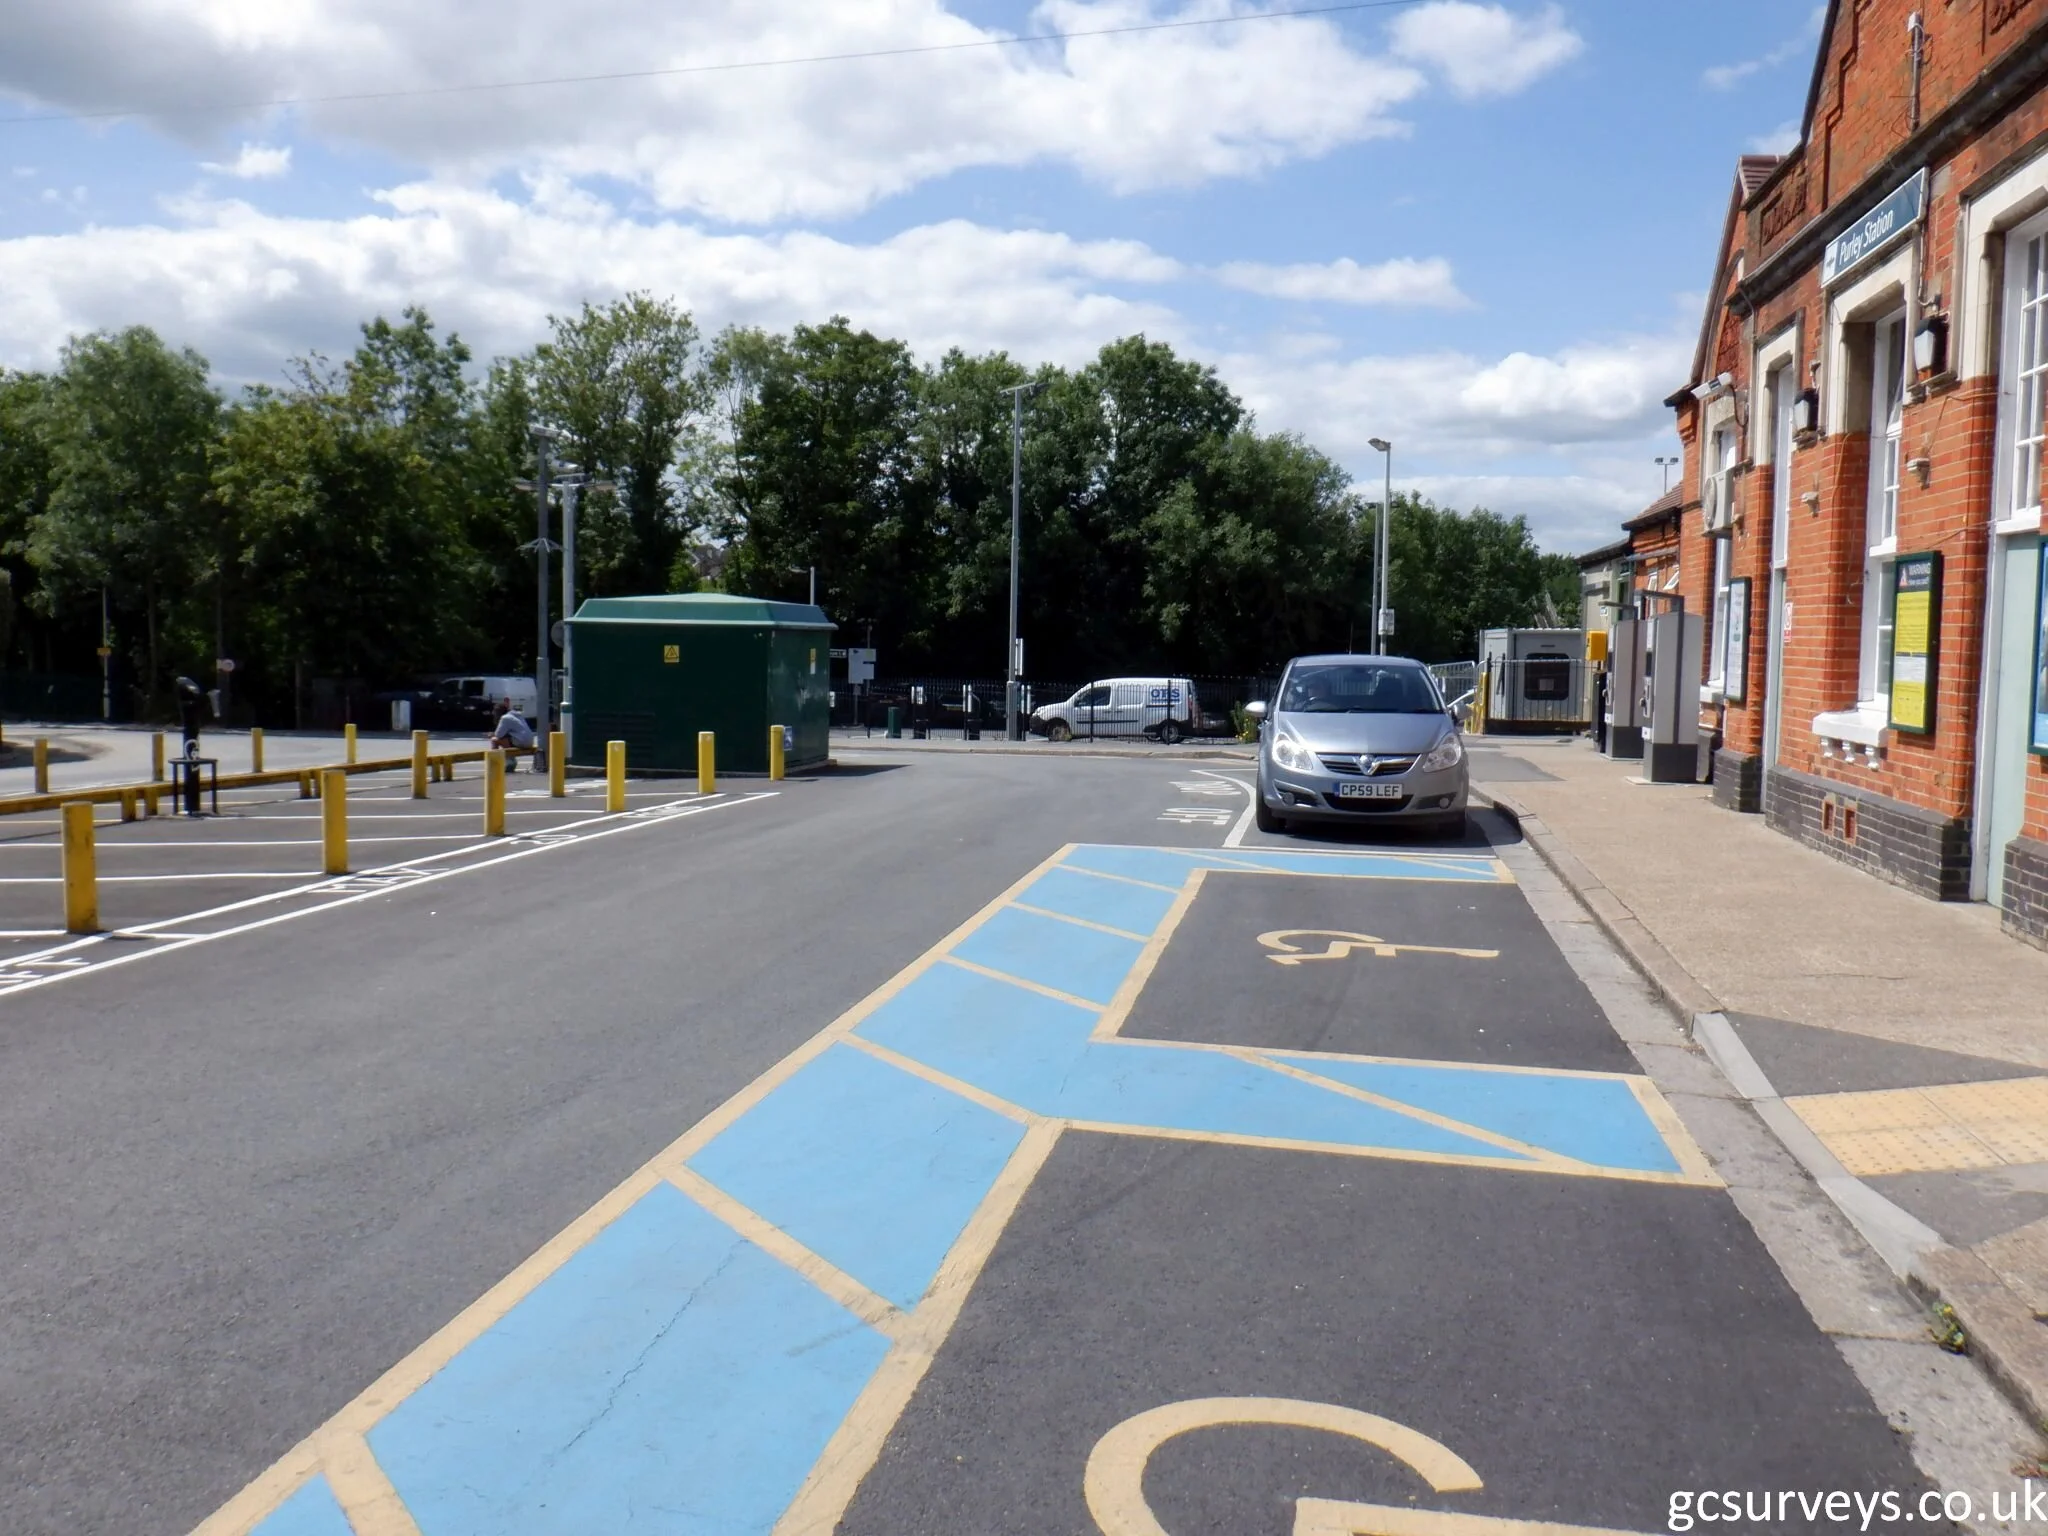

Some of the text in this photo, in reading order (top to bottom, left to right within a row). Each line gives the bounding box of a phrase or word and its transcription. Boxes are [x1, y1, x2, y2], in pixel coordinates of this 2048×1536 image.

[1839, 209, 1894, 265] Purley Station
[1341, 784, 1400, 797] CP59 LEF
[0, 955, 90, 984] FF
[307, 867, 450, 893] MAX
